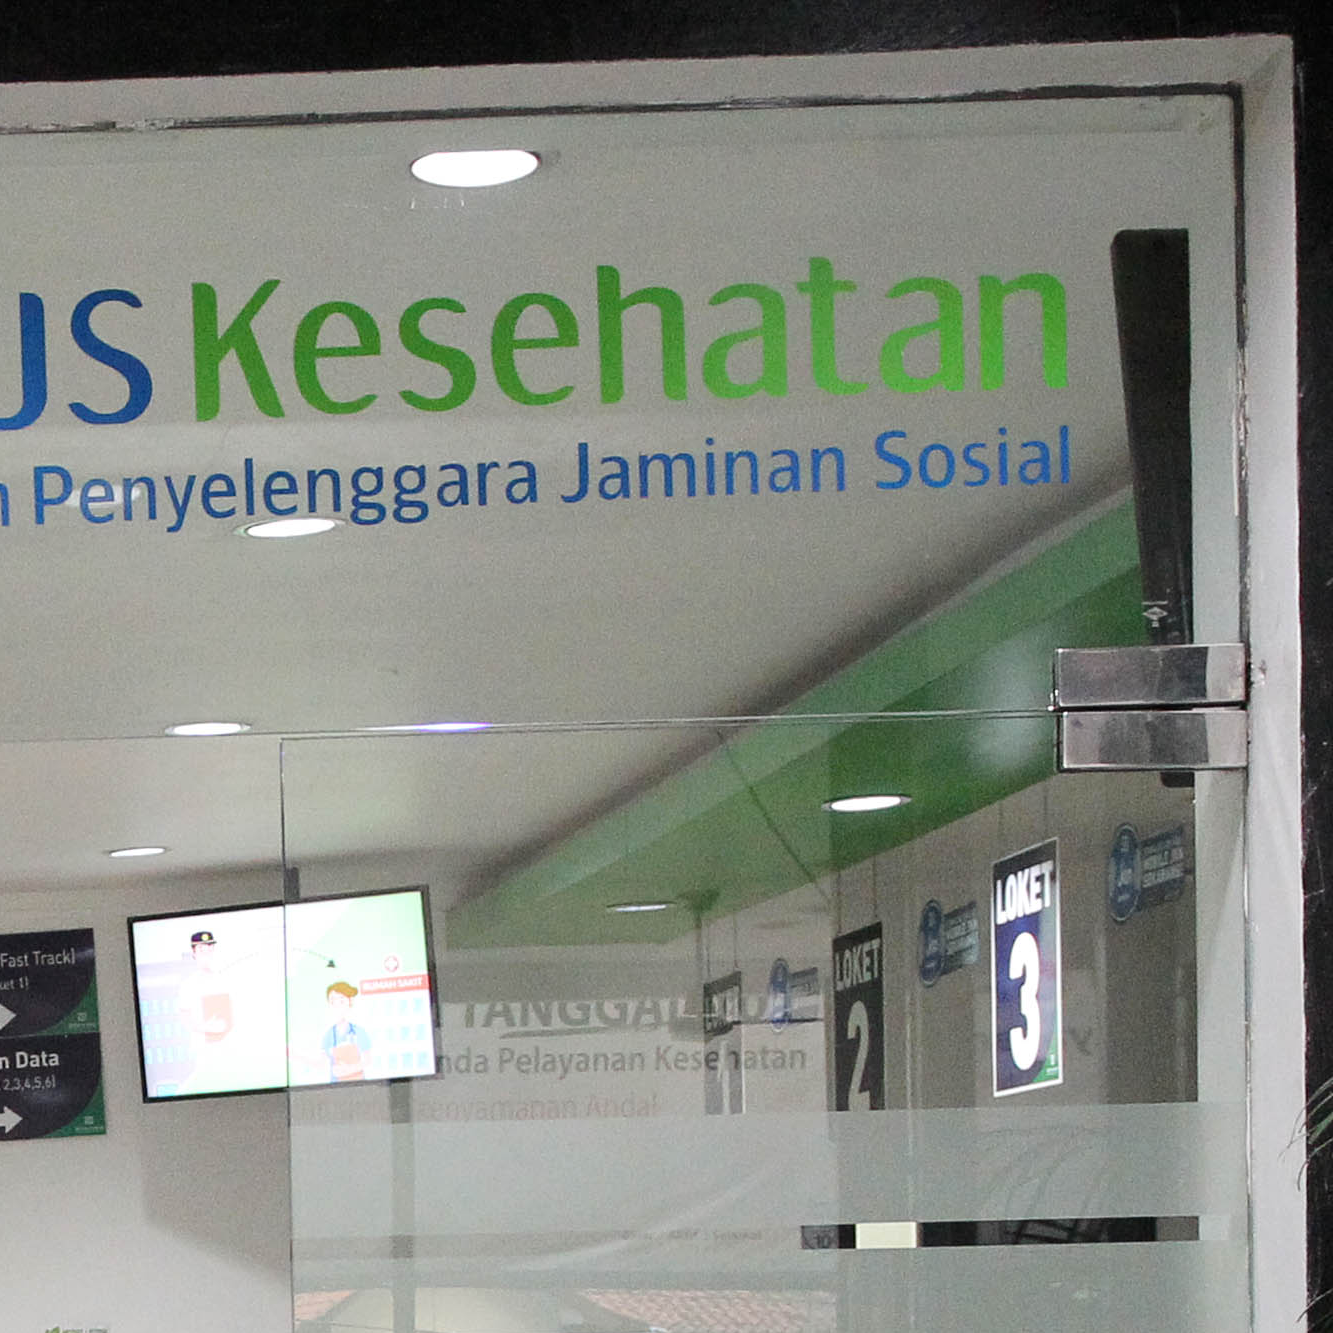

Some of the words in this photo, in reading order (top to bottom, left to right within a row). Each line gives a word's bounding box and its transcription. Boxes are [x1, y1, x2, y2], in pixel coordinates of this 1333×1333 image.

[191, 254, 1069, 422] Kesehatan
[33, 456, 538, 533] Penyelenggara
[560, 437, 848, 505] Jaminan
[874, 425, 1072, 491] Sosial
[995, 860, 1055, 926] LOKET
[32, 947, 77, 966] Track)
[835, 937, 882, 992] LOKET
[1008, 931, 1042, 1071] 3
[16, 1050, 60, 1069] Data
[435, 1050, 488, 1076] nda
[499, 1046, 646, 1081] Pelayanan
[654, 1045, 807, 1074] Kesehatan
[847, 1000, 871, 1111] 2
